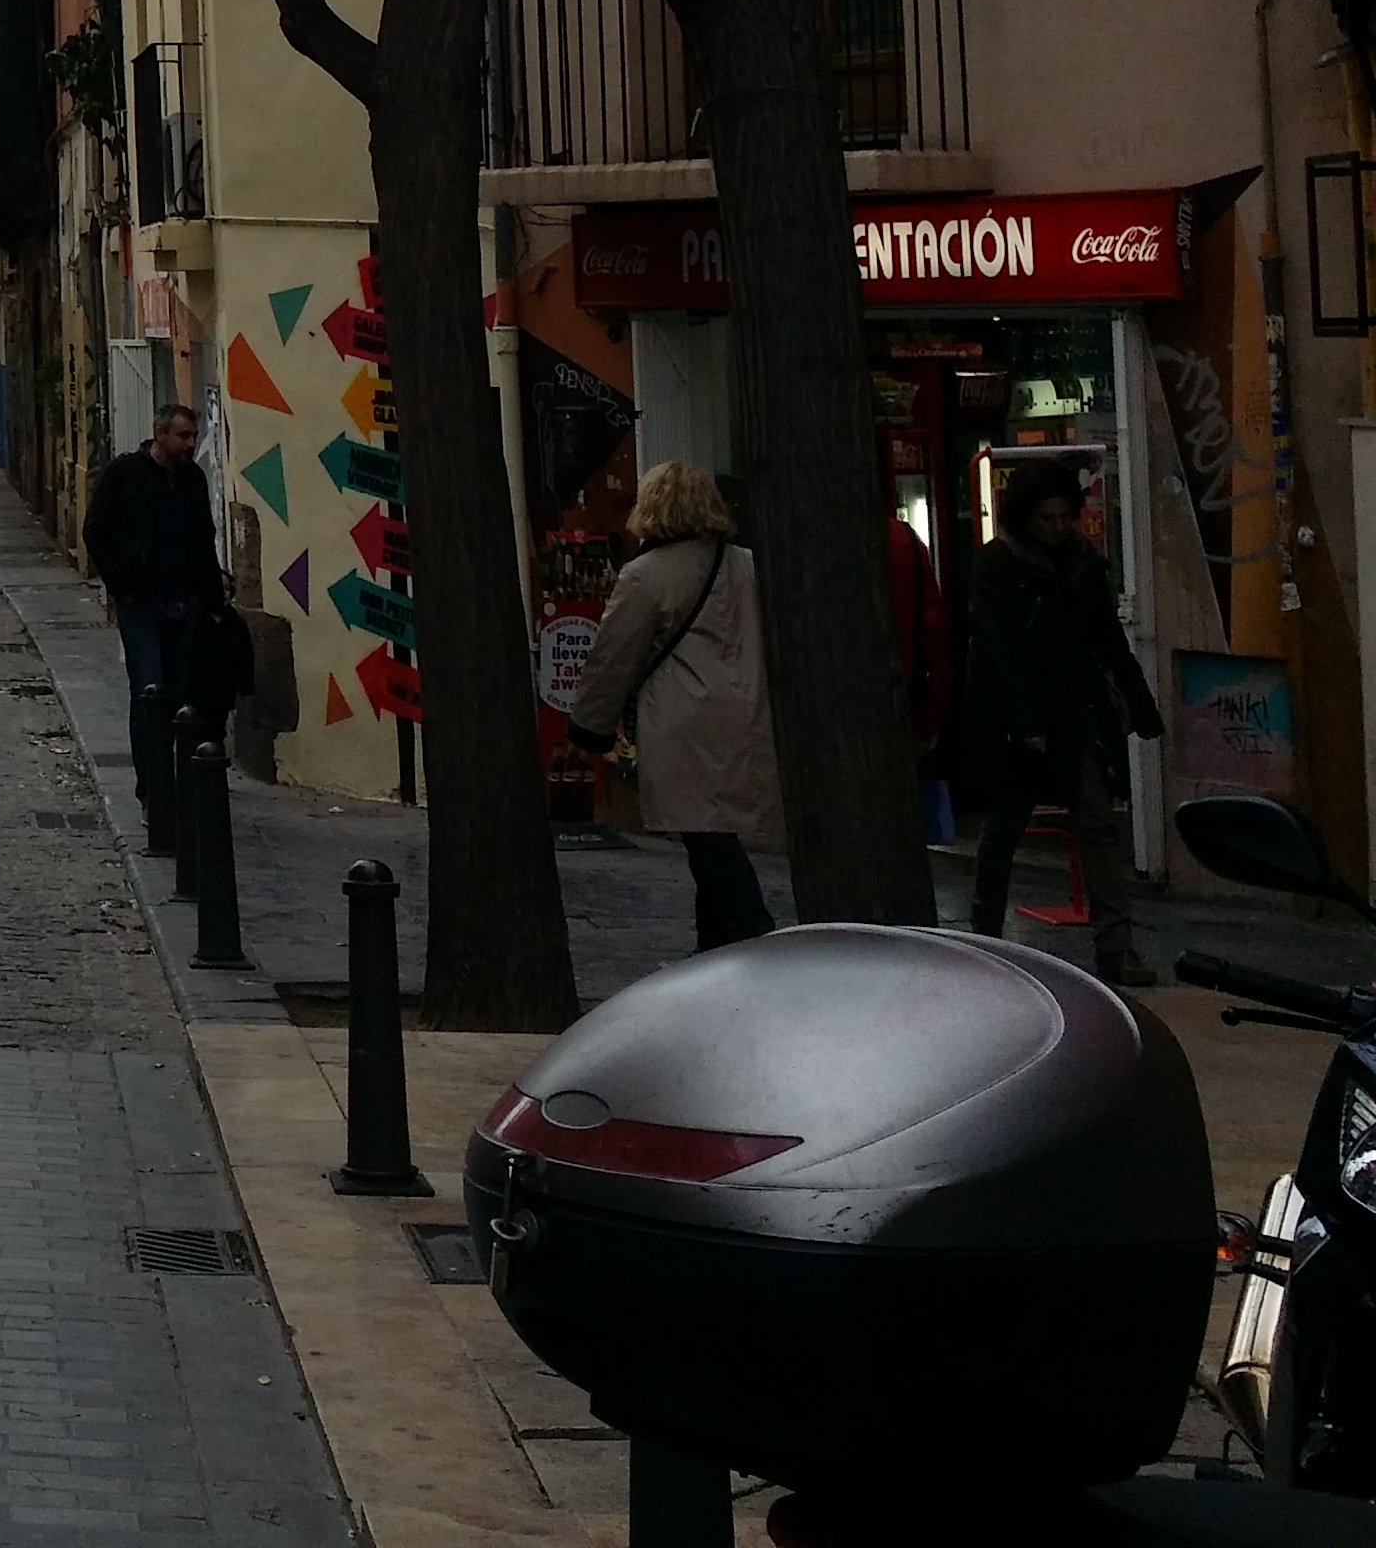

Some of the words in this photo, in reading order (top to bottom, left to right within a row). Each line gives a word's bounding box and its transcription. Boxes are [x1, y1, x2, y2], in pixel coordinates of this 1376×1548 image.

[681, 229, 724, 283] PA
[852, 208, 1035, 280] ENTACIÓN
[1071, 225, 1163, 264] Coca-Cola
[582, 244, 648, 276] Coca-Cola
[353, 315, 385, 337] GALE
[347, 468, 398, 498] VINTAGE
[556, 633, 591, 645] Para
[552, 646, 590, 660] lleva
[553, 663, 583, 677] Tak
